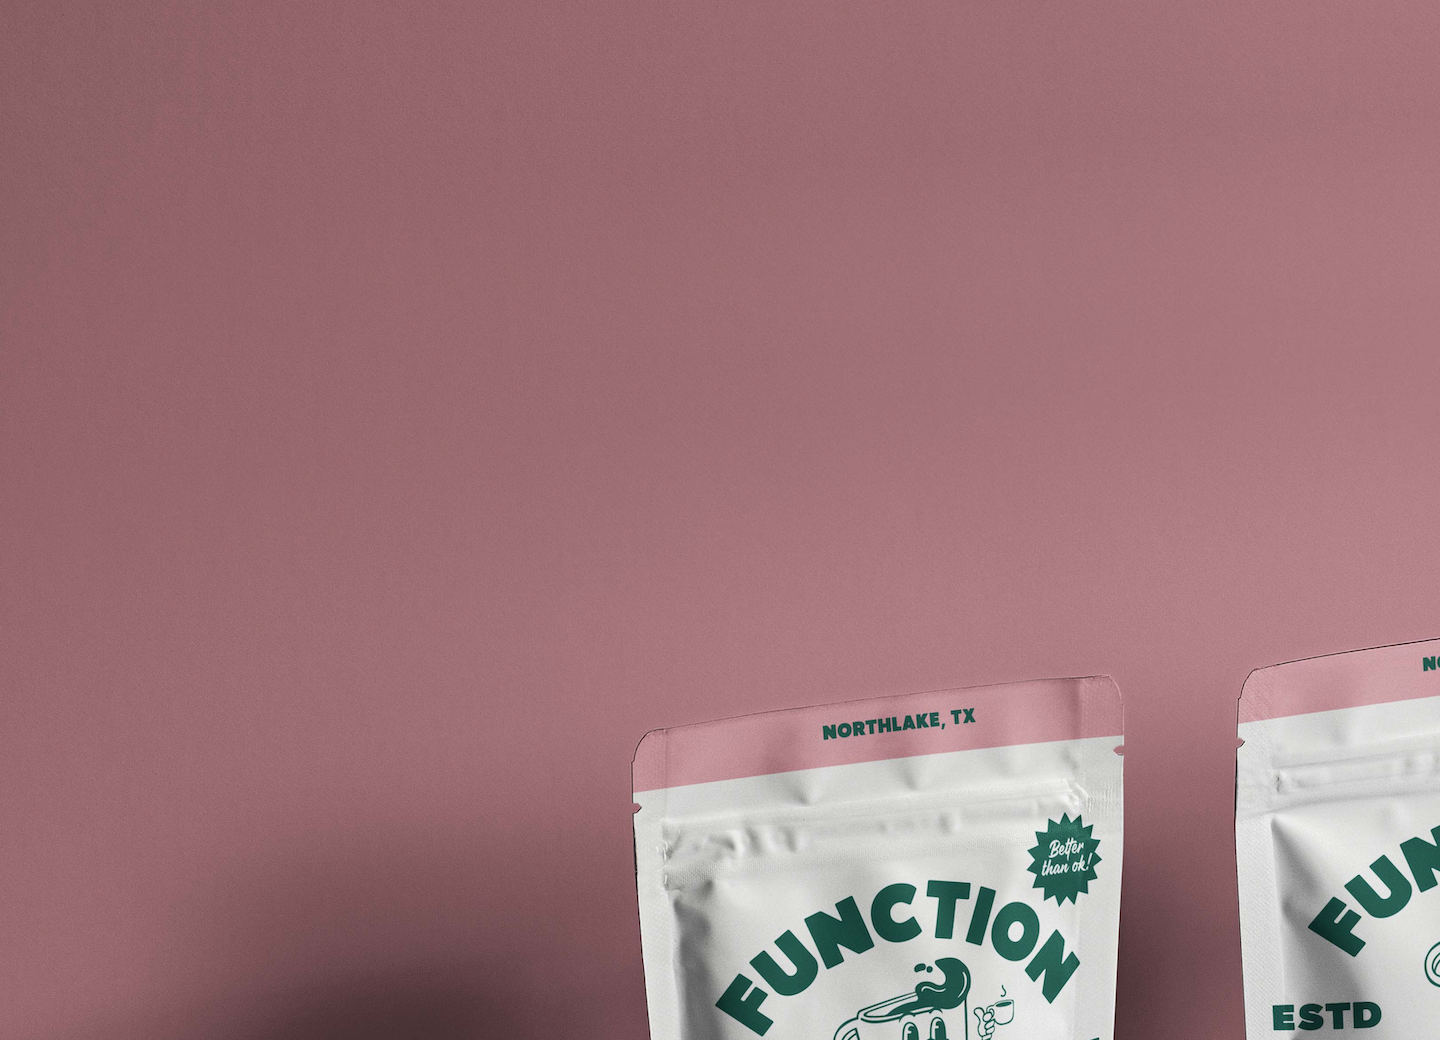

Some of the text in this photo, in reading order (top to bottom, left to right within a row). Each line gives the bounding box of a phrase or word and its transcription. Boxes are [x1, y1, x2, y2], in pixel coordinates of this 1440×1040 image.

[822, 708, 976, 740] NORTHLAKE, TX
[1049, 837, 1084, 861] Better
[1042, 853, 1092, 876] than ok!
[715, 879, 1080, 1037] FUNCTION
[1272, 1001, 1382, 1031] ESTD
